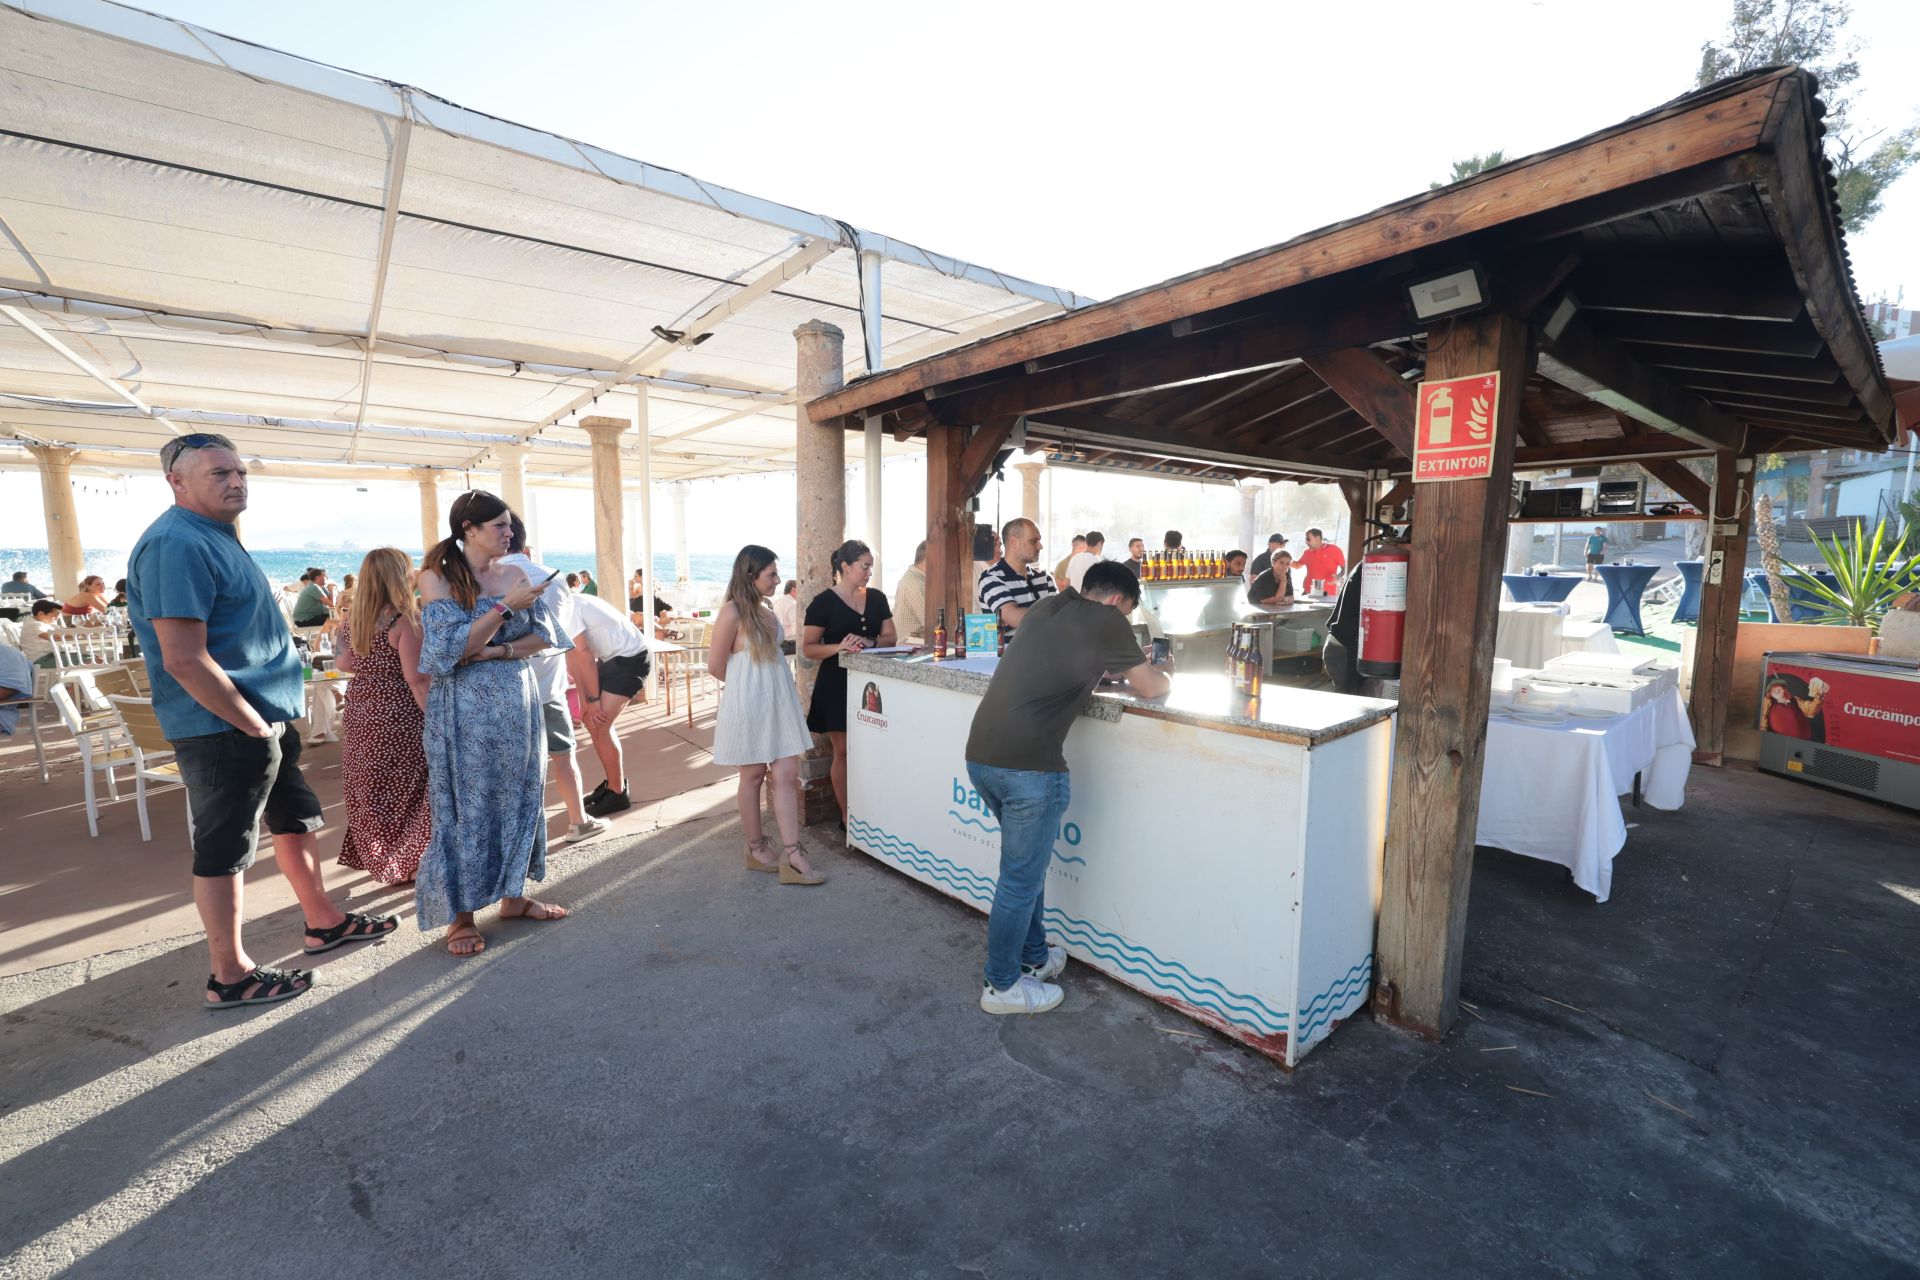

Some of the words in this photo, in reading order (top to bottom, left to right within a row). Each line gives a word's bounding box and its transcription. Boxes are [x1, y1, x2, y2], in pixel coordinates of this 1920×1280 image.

[1418, 456, 1488, 472] EXTINTOR
[857, 711, 888, 728] Cruzcampo
[1843, 702, 1920, 727] Cruzcampo
